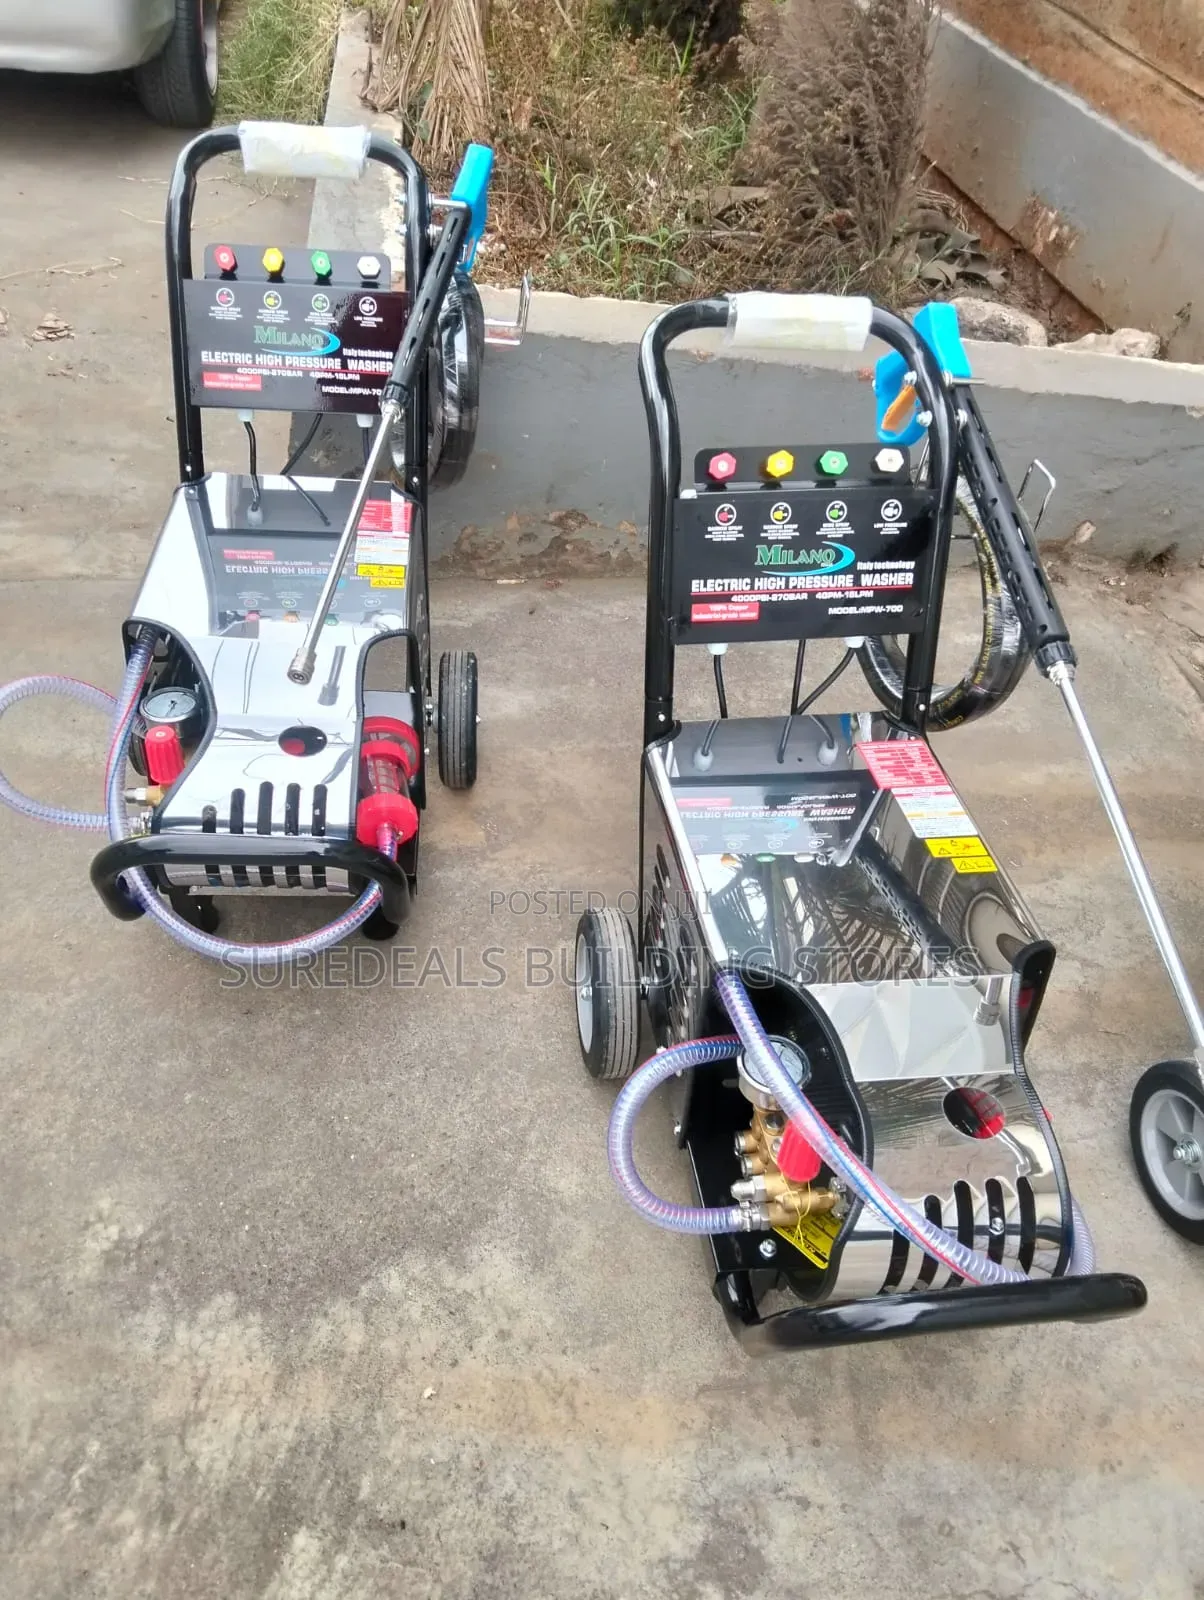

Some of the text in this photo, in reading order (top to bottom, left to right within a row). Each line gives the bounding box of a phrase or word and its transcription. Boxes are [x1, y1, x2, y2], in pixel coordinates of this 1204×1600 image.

[253, 325, 324, 347] MILANO
[200, 350, 394, 373] ELECTRIC HIGH PRESSURE WASHER
[321, 385, 383, 396] MODEL:MPW-70
[754, 544, 836, 567] MILANO
[856, 560, 916, 570] Italy technology
[691, 572, 914, 593] ELECTRIC HIGH PRESSURE WASHER
